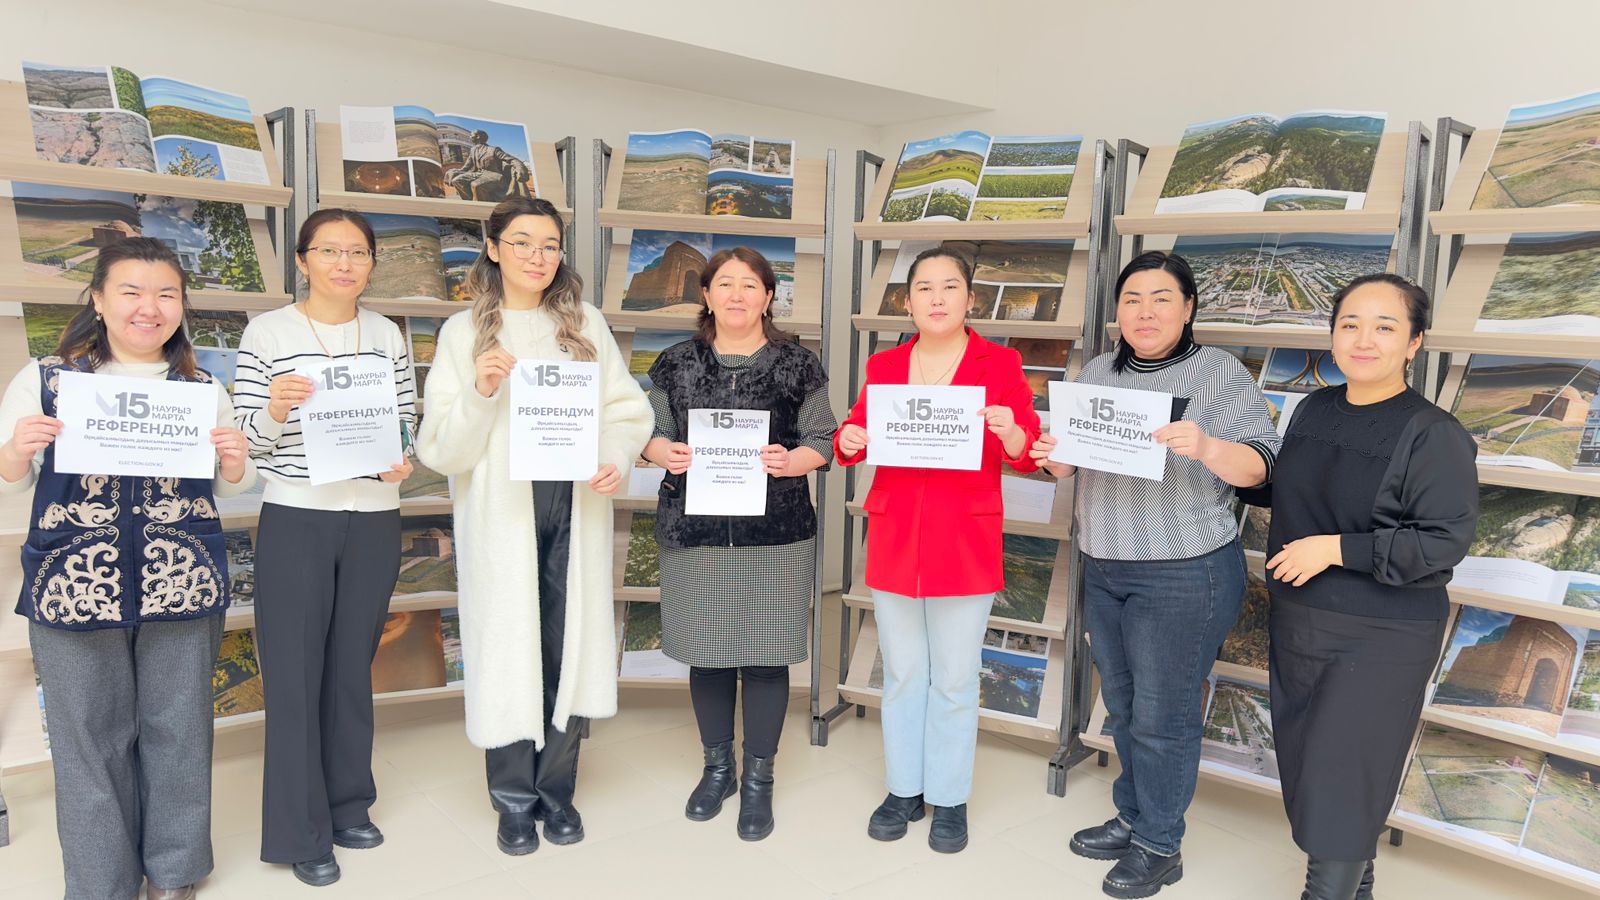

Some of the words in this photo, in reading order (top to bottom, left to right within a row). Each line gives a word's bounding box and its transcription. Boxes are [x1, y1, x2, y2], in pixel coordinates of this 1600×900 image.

[321, 366, 352, 390] 15
[353, 371, 387, 380] НАУРЫЗ
[354, 379, 382, 387] МАРТА
[534, 365, 561, 387] 15
[115, 392, 150, 419] 15
[152, 404, 191, 414] НАУРЫЗ
[518, 407, 594, 418] РЕФЕРЕНДУМ
[906, 398, 932, 421] 15
[1090, 397, 1115, 422] 15
[152, 413, 185, 422] МАРТА
[309, 406, 393, 421] РЕФЕРЕНДУМ
[710, 412, 735, 429] 15
[1116, 409, 1148, 420] НАУРЫЗ
[86, 418, 198, 437] РЕФЕРЕНДУМ
[886, 422, 969, 435] РЕФЕРЕНДУМ
[1069, 417, 1152, 442] РЕФЕРЕНДУМ
[1116, 417, 1141, 427] МАРТА
